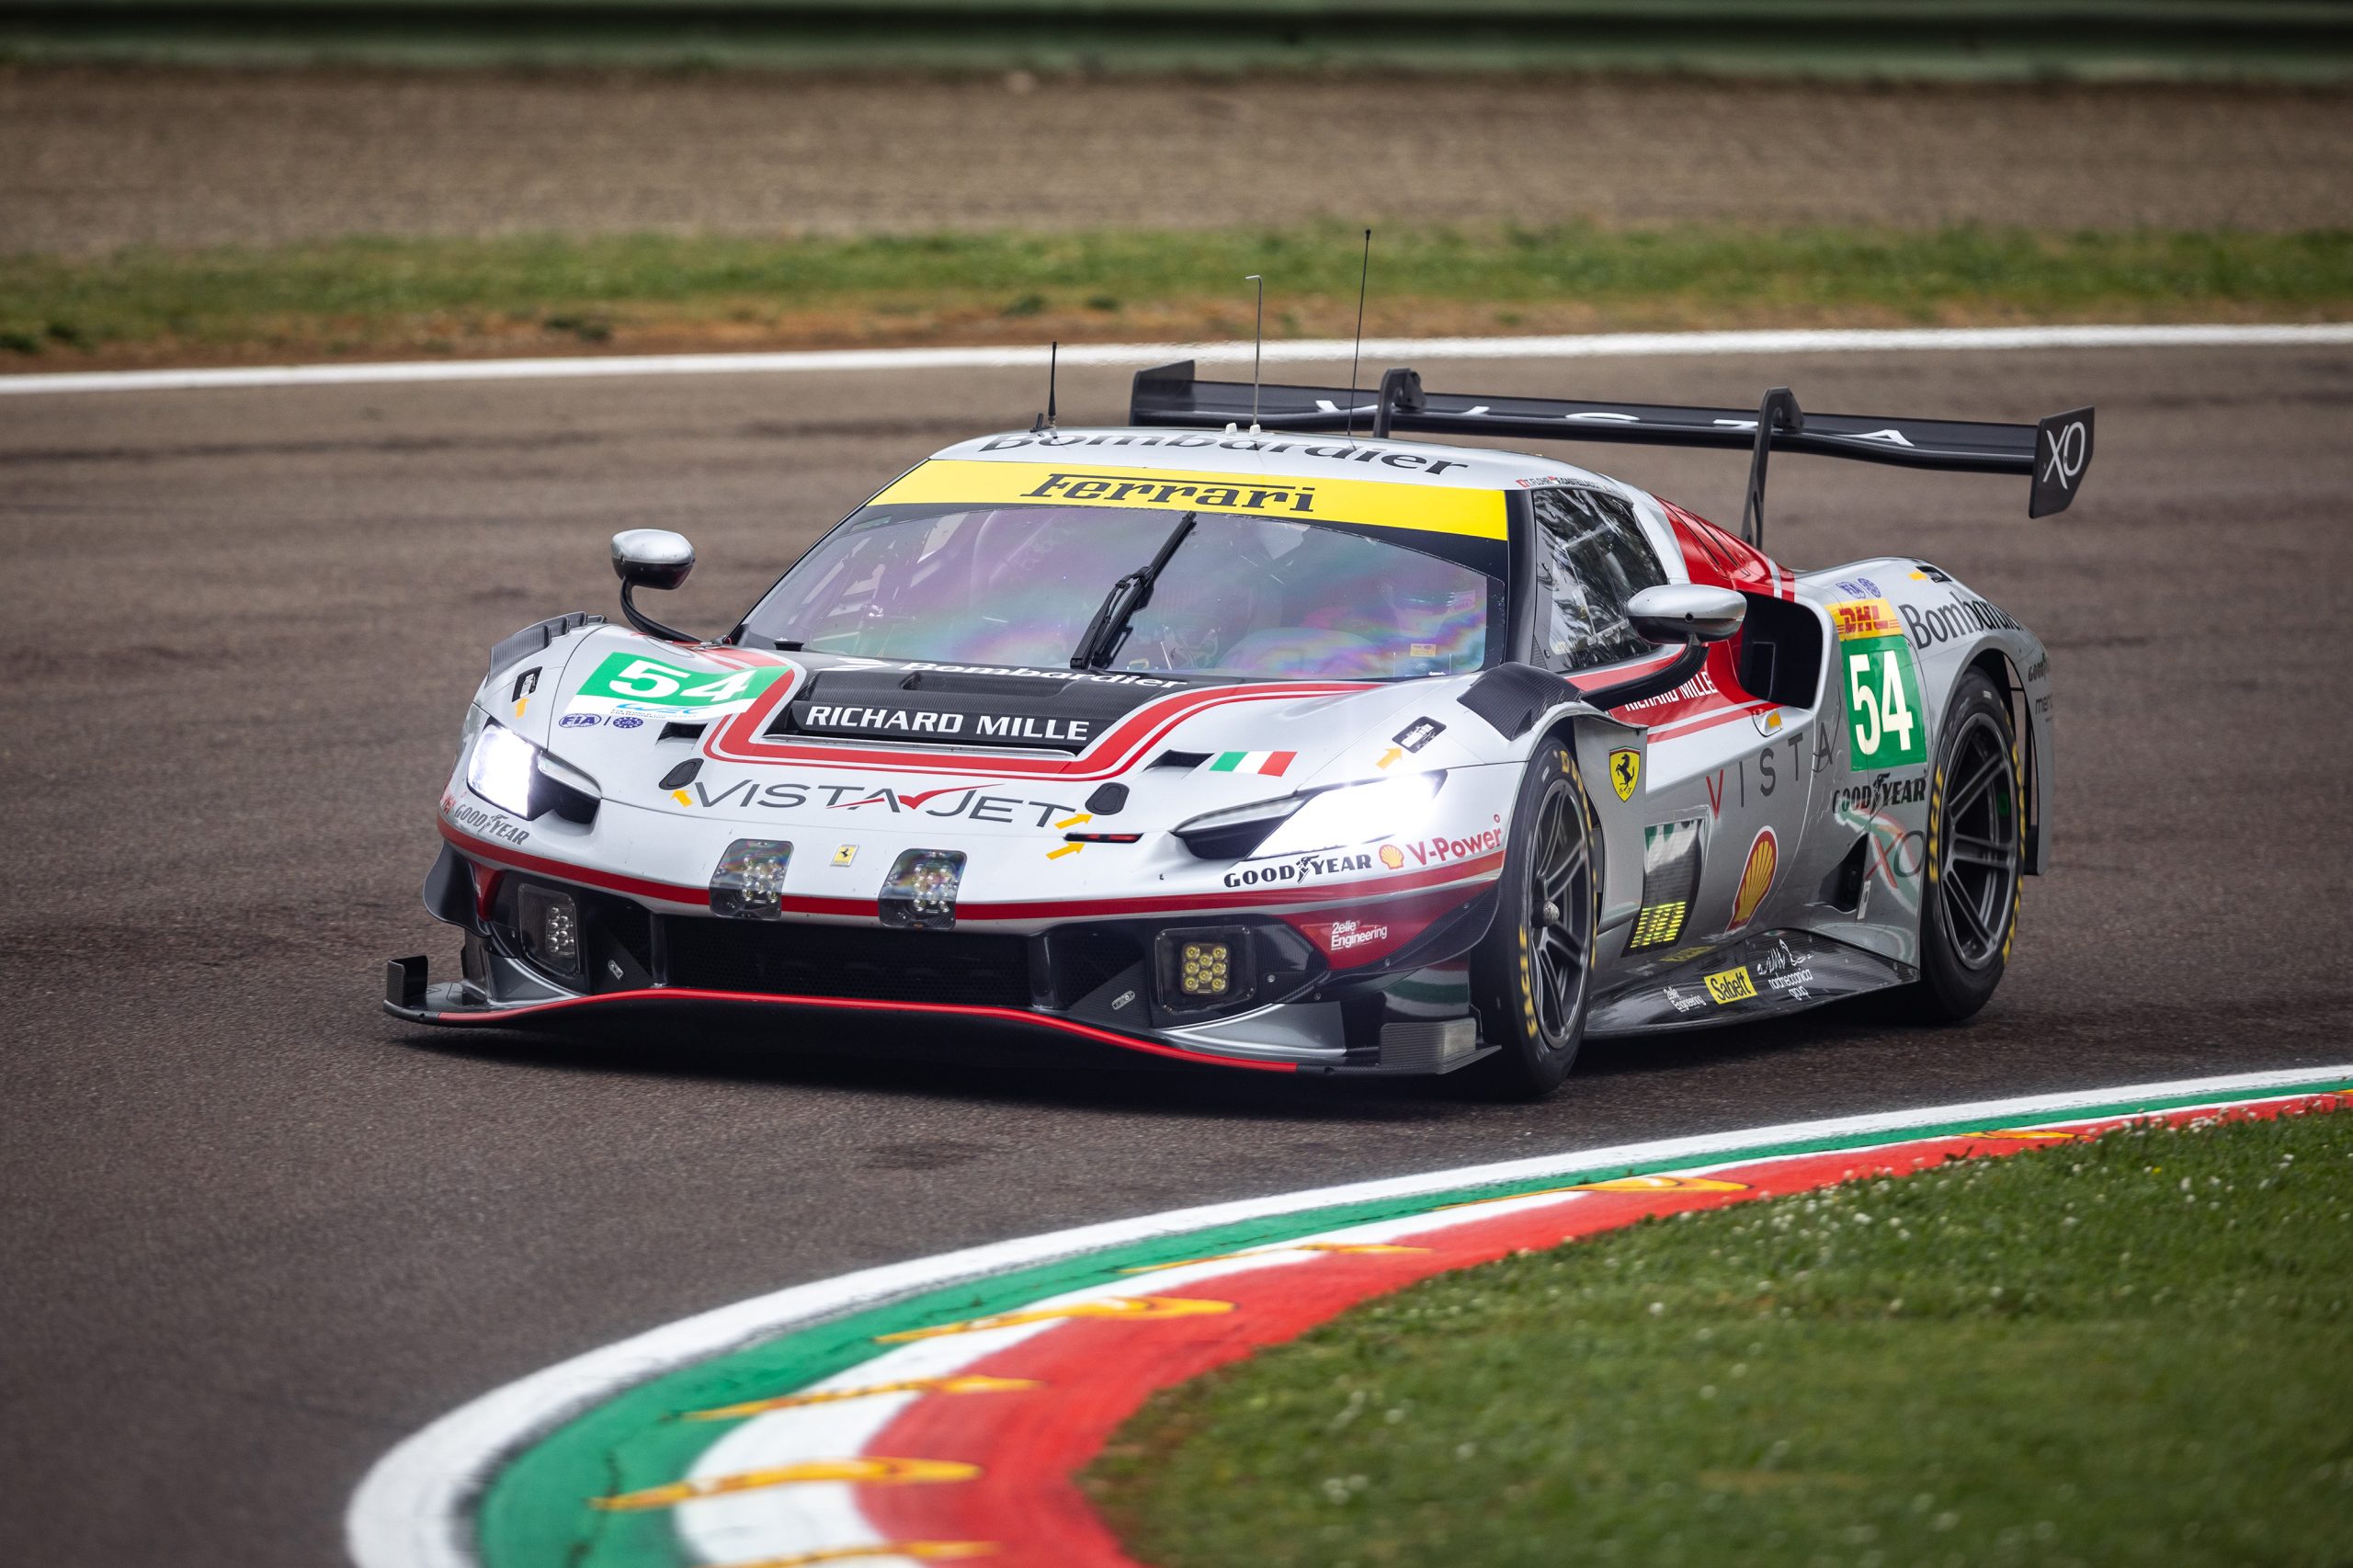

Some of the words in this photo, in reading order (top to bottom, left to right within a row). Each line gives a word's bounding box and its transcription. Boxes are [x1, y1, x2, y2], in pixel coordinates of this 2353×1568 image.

[978, 433, 1468, 475] Bombardier
[2042, 421, 2086, 490] XO
[1020, 473, 1315, 512] Ferrari
[1839, 605, 1889, 633] DHL
[608, 659, 757, 702] 54
[898, 662, 1188, 688] Bombardier
[561, 715, 597, 726] FIA
[1849, 650, 1914, 755] 54
[805, 705, 963, 733] RICHARD
[975, 715, 1089, 741] MILLE
[453, 803, 530, 846] GOODYEAR
[1406, 824, 1502, 866] V-Power
[1864, 830, 1926, 889] XO
[1223, 853, 1372, 888] GOODYEAR
[1331, 926, 1388, 948] Engineering
[1332, 920, 1357, 935] 2elle
[1711, 971, 1752, 1001] Sabelt
